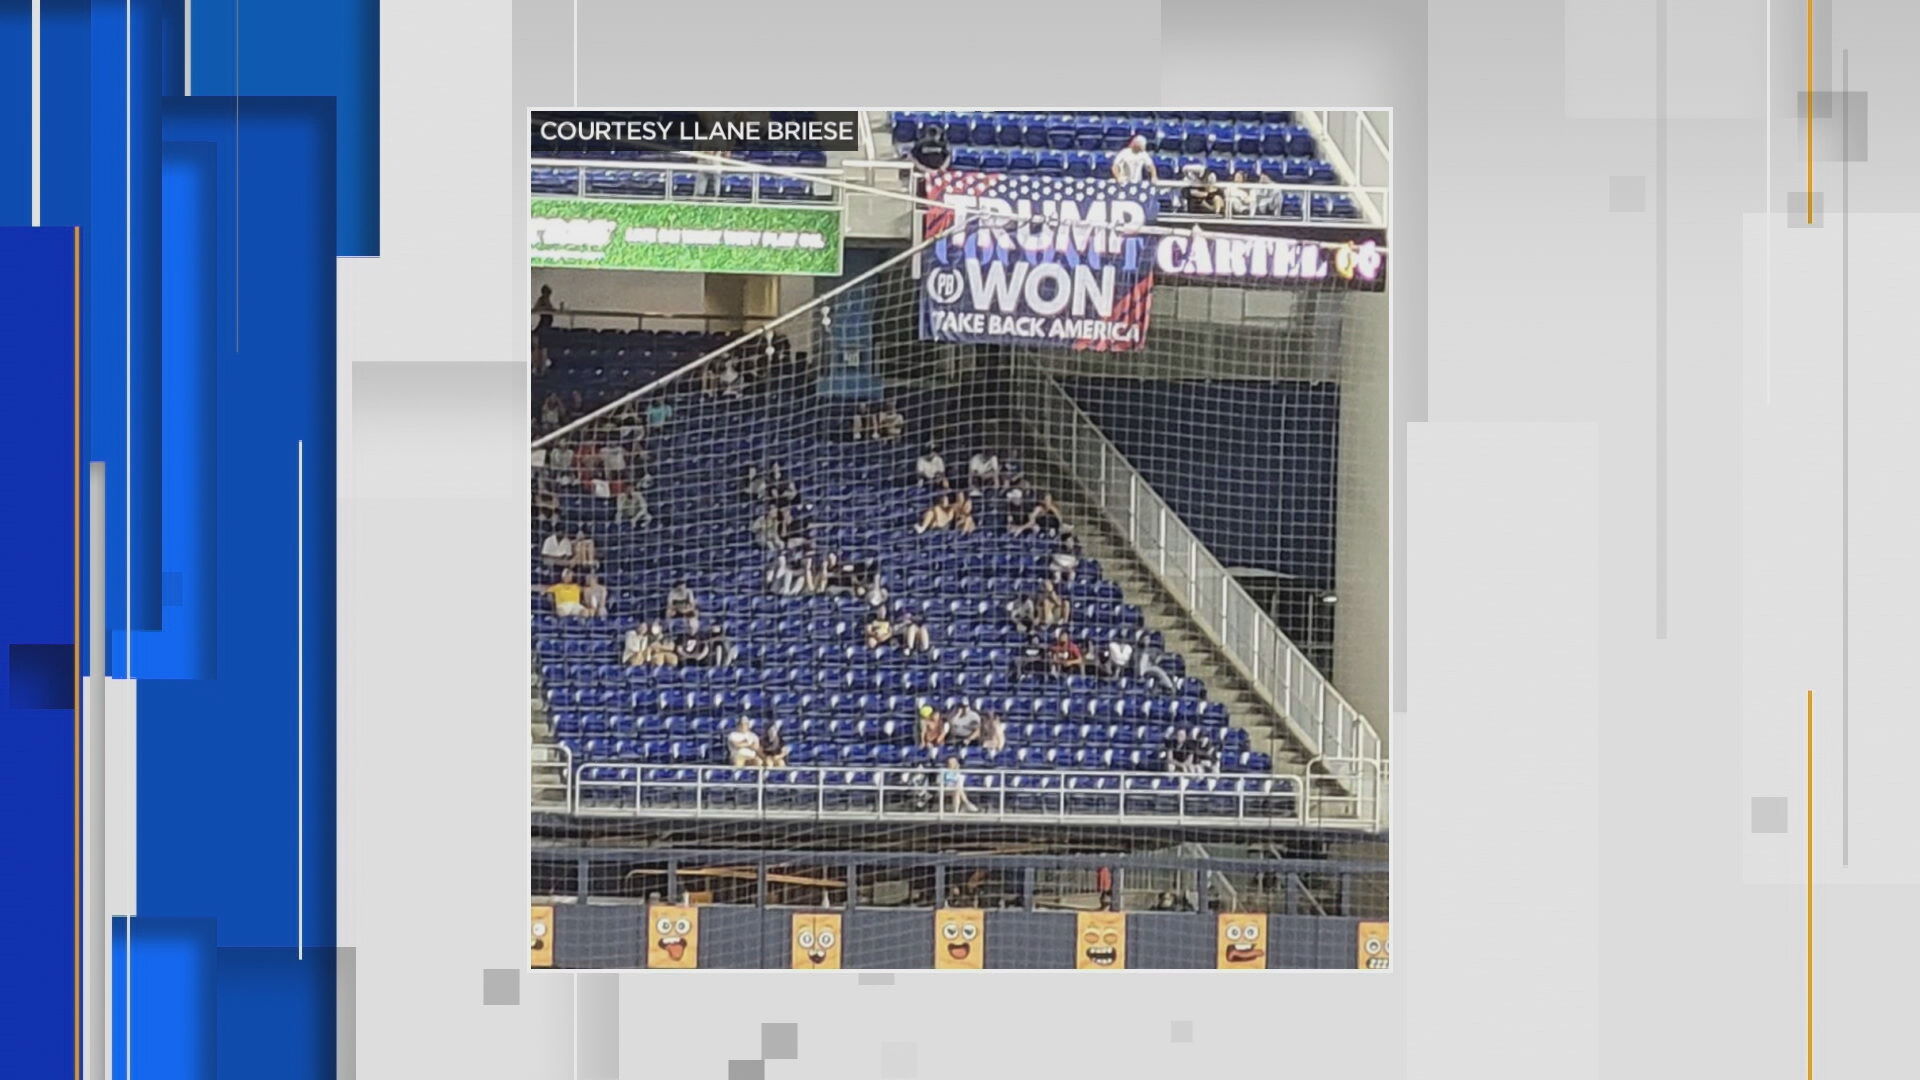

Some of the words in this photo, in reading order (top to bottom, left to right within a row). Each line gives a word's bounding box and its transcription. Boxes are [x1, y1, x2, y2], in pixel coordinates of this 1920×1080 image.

[943, 193, 1146, 254] TRUMP
[1157, 234, 1328, 279] CARTEL
[965, 257, 1116, 318] WON
[933, 311, 985, 334] TAKE
[988, 315, 1046, 338] BACK
[1048, 319, 1141, 342] AMERICA
